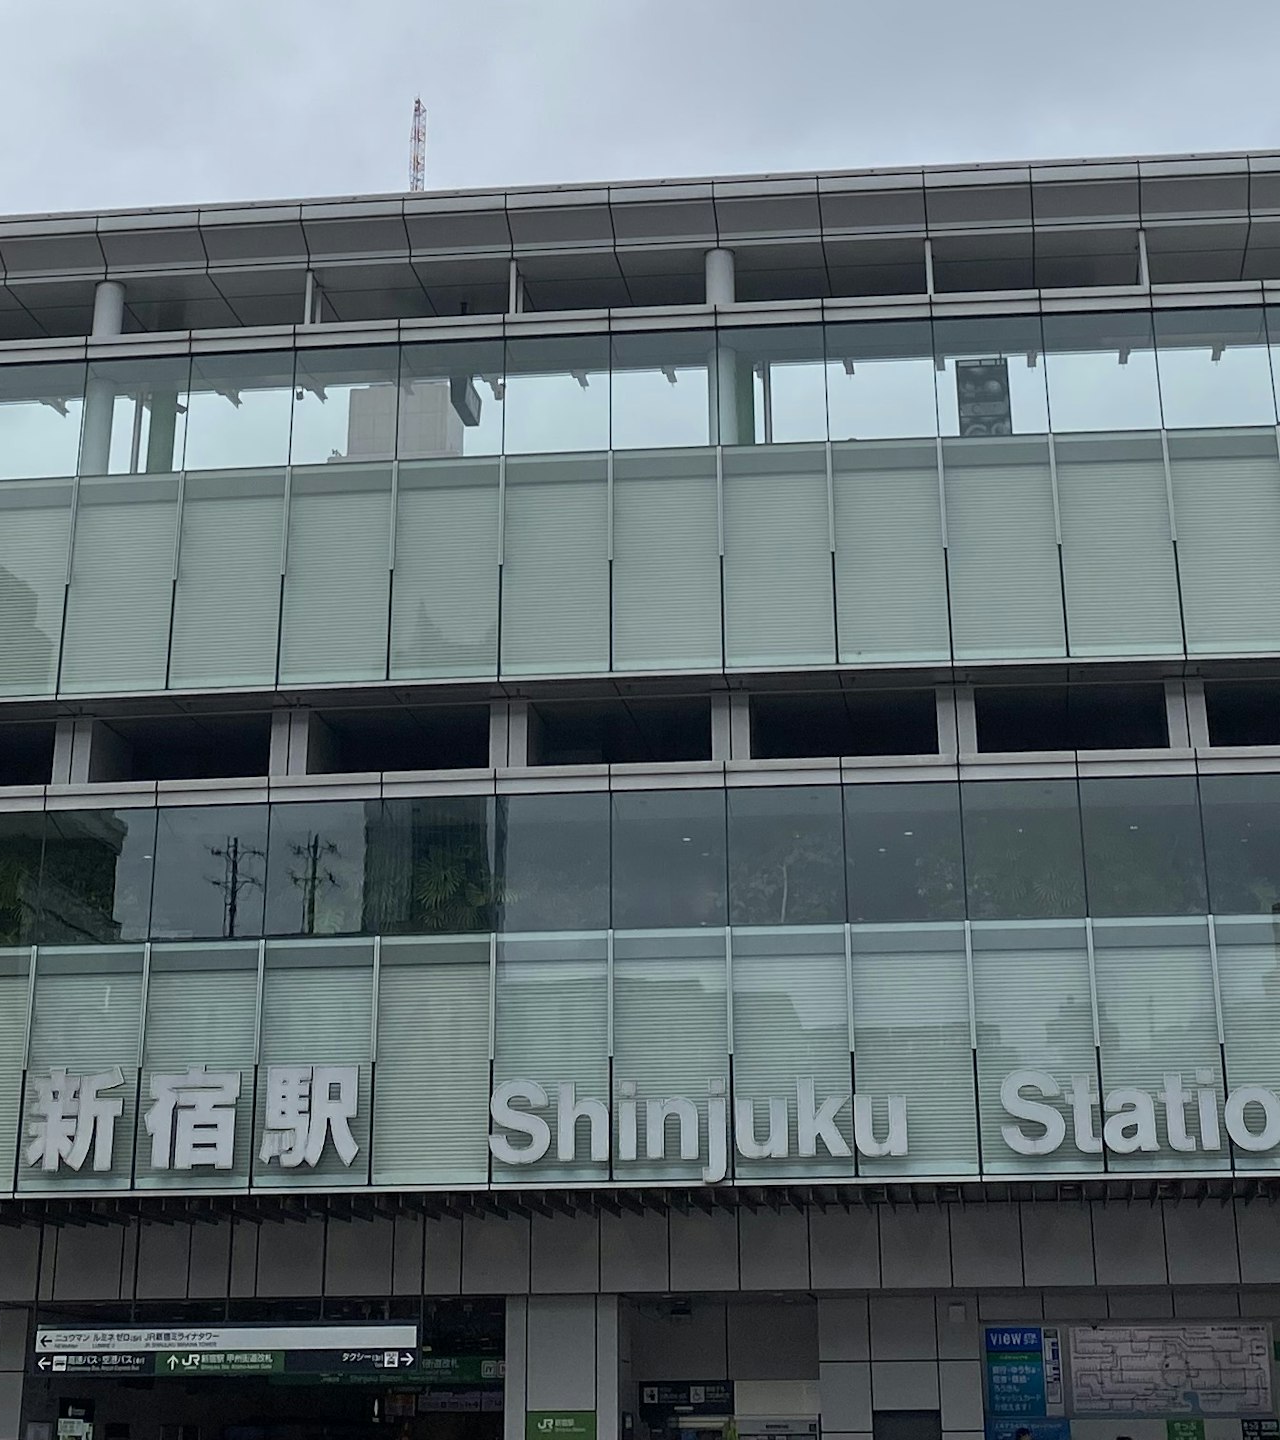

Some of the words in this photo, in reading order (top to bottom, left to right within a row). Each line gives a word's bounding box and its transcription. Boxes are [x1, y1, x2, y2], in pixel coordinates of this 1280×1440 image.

[26, 1064, 360, 1172] 新宿駅
[488, 1076, 908, 1183] Shinjuku
